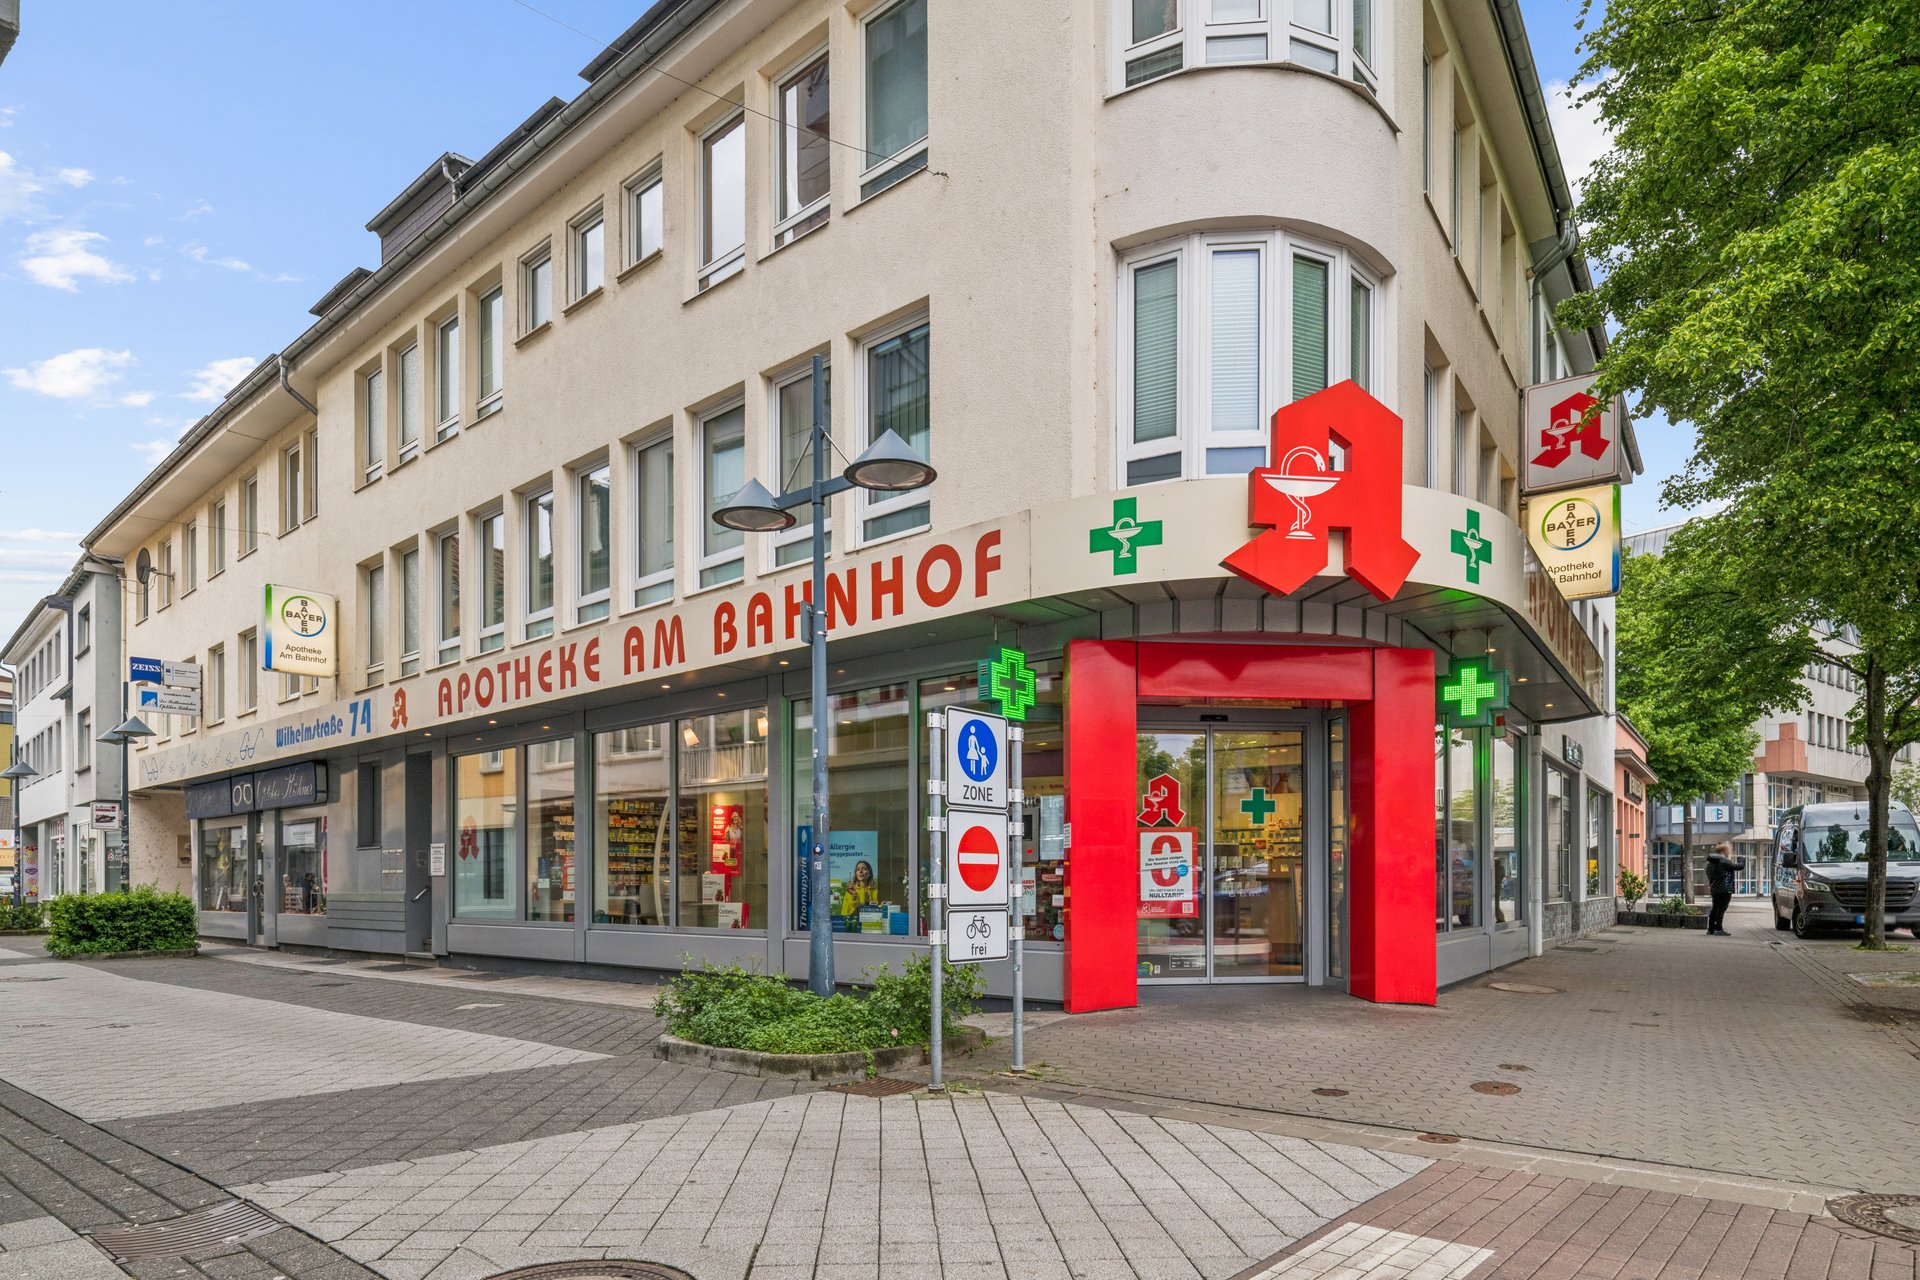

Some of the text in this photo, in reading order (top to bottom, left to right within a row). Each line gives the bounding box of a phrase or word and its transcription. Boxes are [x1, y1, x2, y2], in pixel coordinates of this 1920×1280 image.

[1547, 517, 1596, 532] BAYER
[1566, 503, 1576, 546] BAYER
[1547, 561, 1595, 575] Apotheke
[1559, 570, 1602, 583] Bahnhof
[286, 610, 323, 623] BAYER
[300, 600, 308, 634] BAYER
[438, 529, 1001, 717] APOTHEKE AM BAHNHOF
[285, 644, 322, 655] Apotheke
[280, 652, 327, 664] Am Bahnhof
[132, 663, 161, 673] ZEISS
[276, 698, 371, 748] Wilhelmstraße 74
[962, 785, 993, 802] ZONE
[829, 843, 856, 857] Allergie
[799, 857, 809, 928] Thomapyrin
[971, 942, 987, 956] frei
